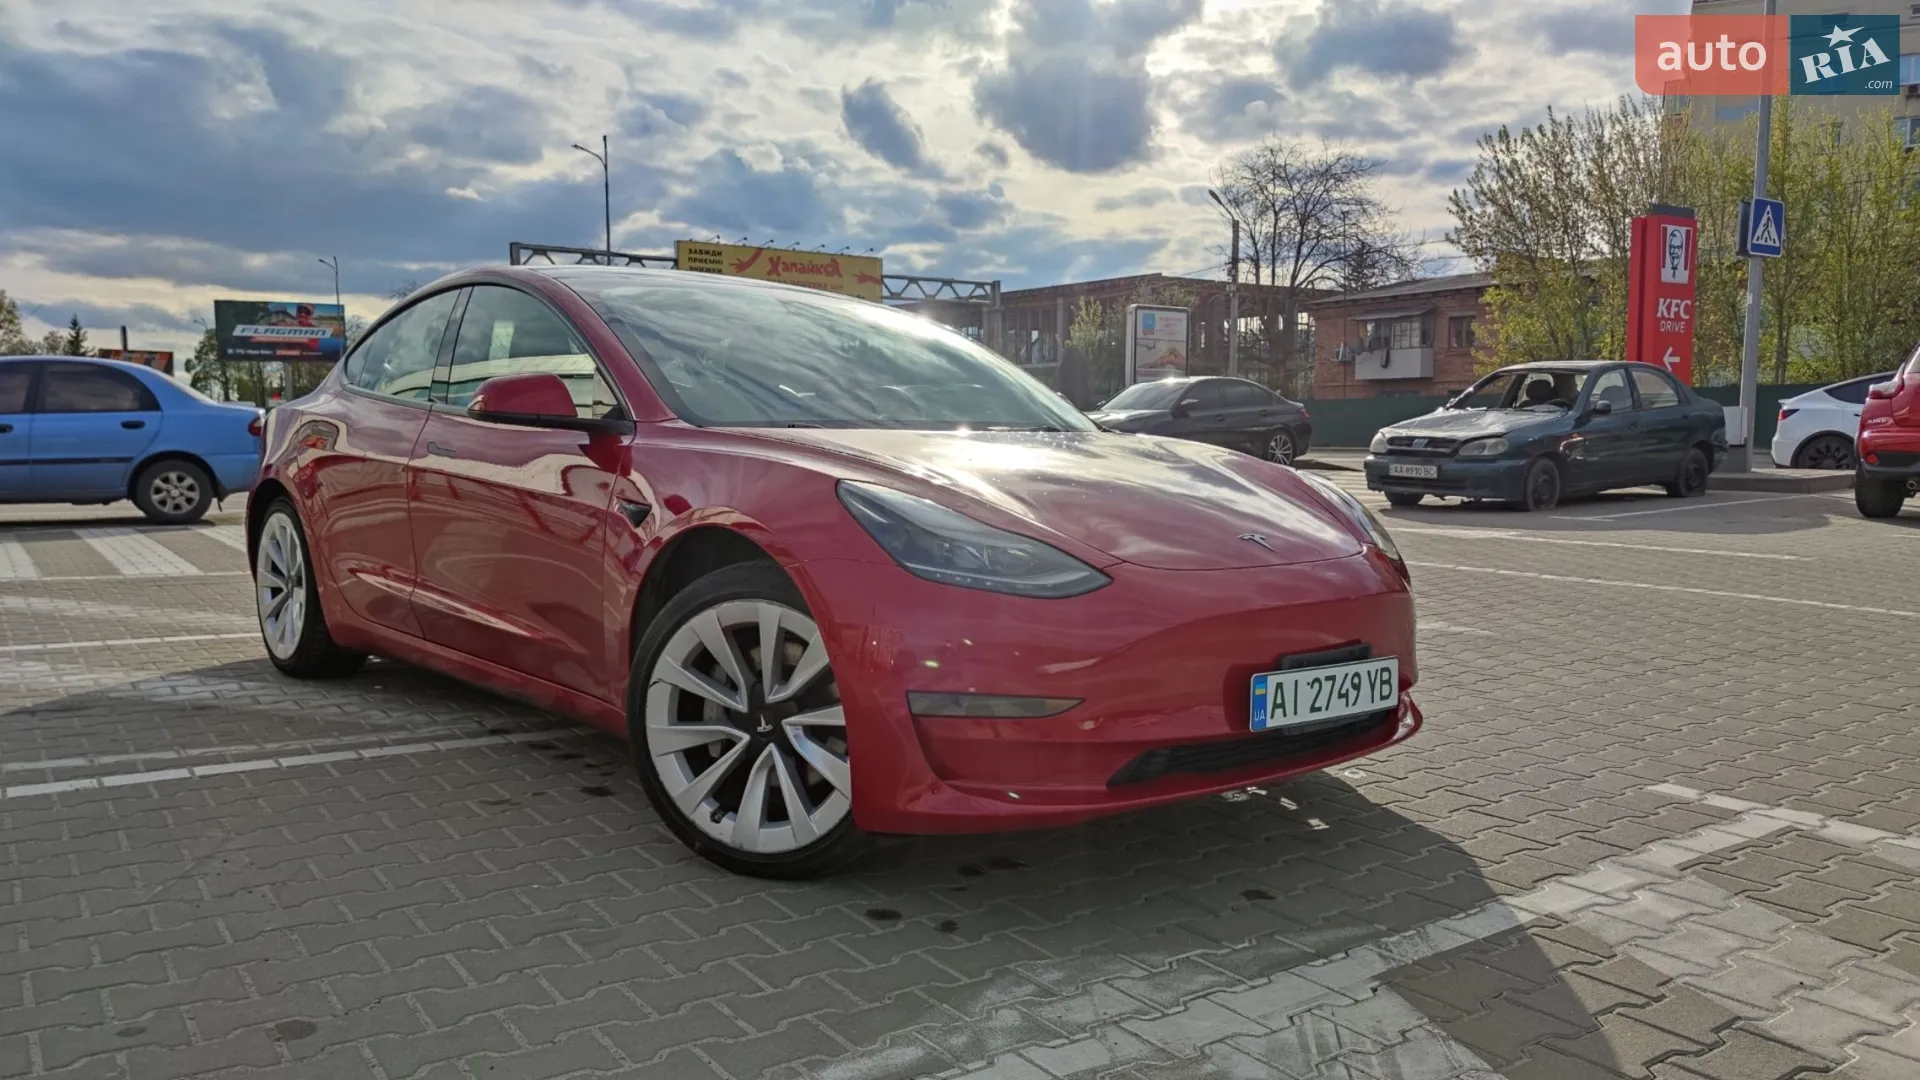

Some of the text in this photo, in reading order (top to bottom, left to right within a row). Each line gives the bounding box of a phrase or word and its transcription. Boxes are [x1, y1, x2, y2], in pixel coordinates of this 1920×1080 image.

[688, 248, 722, 257] ЗАВЖДИ
[1656, 297, 1691, 319] KFC
[240, 327, 327, 336] FLAGMAN
[1660, 320, 1686, 333] DRIVE
[1270, 666, 1393, 719] AI 2749 YB
[1254, 709, 1266, 721] UA
